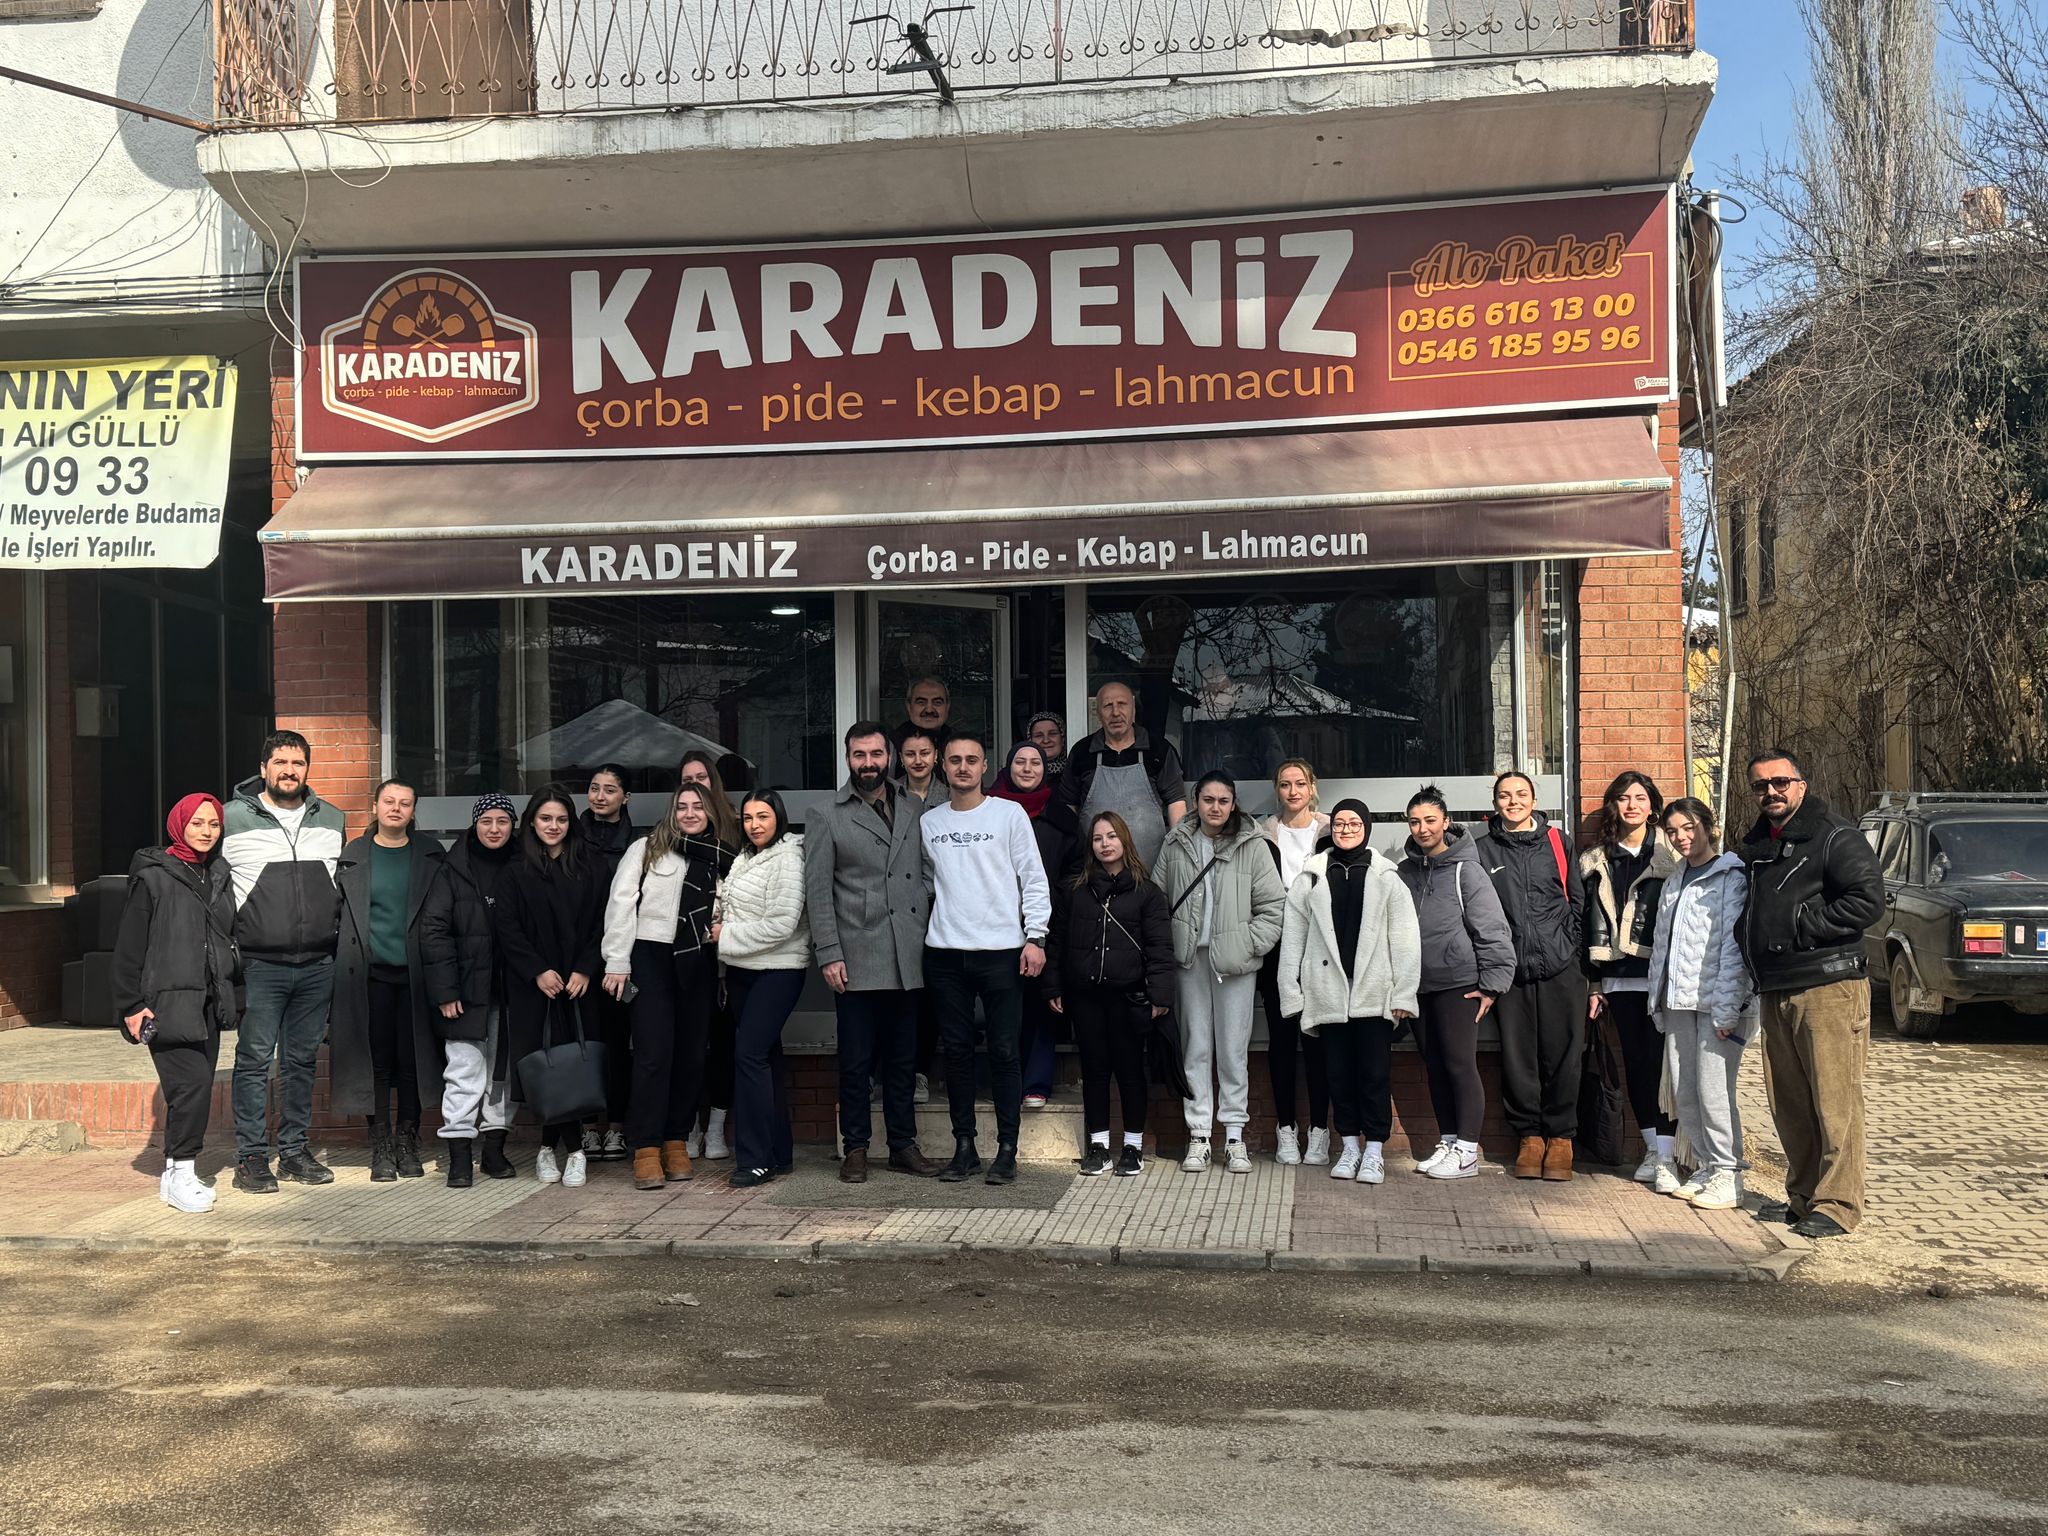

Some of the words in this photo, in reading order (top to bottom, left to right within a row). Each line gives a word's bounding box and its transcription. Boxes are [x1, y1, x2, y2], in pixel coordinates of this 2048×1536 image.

[1411, 241, 1494, 297] Alo
[1495, 232, 1625, 286] Paket
[1397, 304, 1475, 333] 0366
[1485, 299, 1540, 324] 616
[1550, 296, 1584, 321] 13
[1593, 292, 1636, 317] 00
[1397, 337, 1477, 365] 0546
[1488, 332, 1542, 358] 185
[1552, 328, 1591, 354] 95
[1600, 325, 1640, 351] 96
[343, 386, 375, 399] çorba
[385, 385, 410, 399] pide
[420, 385, 454, 398] kebap
[464, 385, 518, 396] lahmacun
[576, 387, 710, 437] çorba
[762, 381, 863, 431] pide
[916, 375, 1061, 420] kebap
[1115, 363, 1354, 407] lahmacun
[13, 421, 56, 448] Ali
[67, 415, 180, 448] GÜLLÜ
[25, 456, 79, 496] 09
[96, 456, 150, 496] 33
[10, 503, 129, 531] Meyvelerde
[136, 502, 220, 524] Budama
[27, 532, 79, 563] İşleri
[87, 536, 156, 562] Yapılır.
[521, 534, 798, 584] KARADENİZ
[867, 543, 958, 580] Çorba
[982, 540, 1050, 571] Pide
[1077, 536, 1176, 570] Kebap
[1202, 529, 1369, 560] Lahmacun
